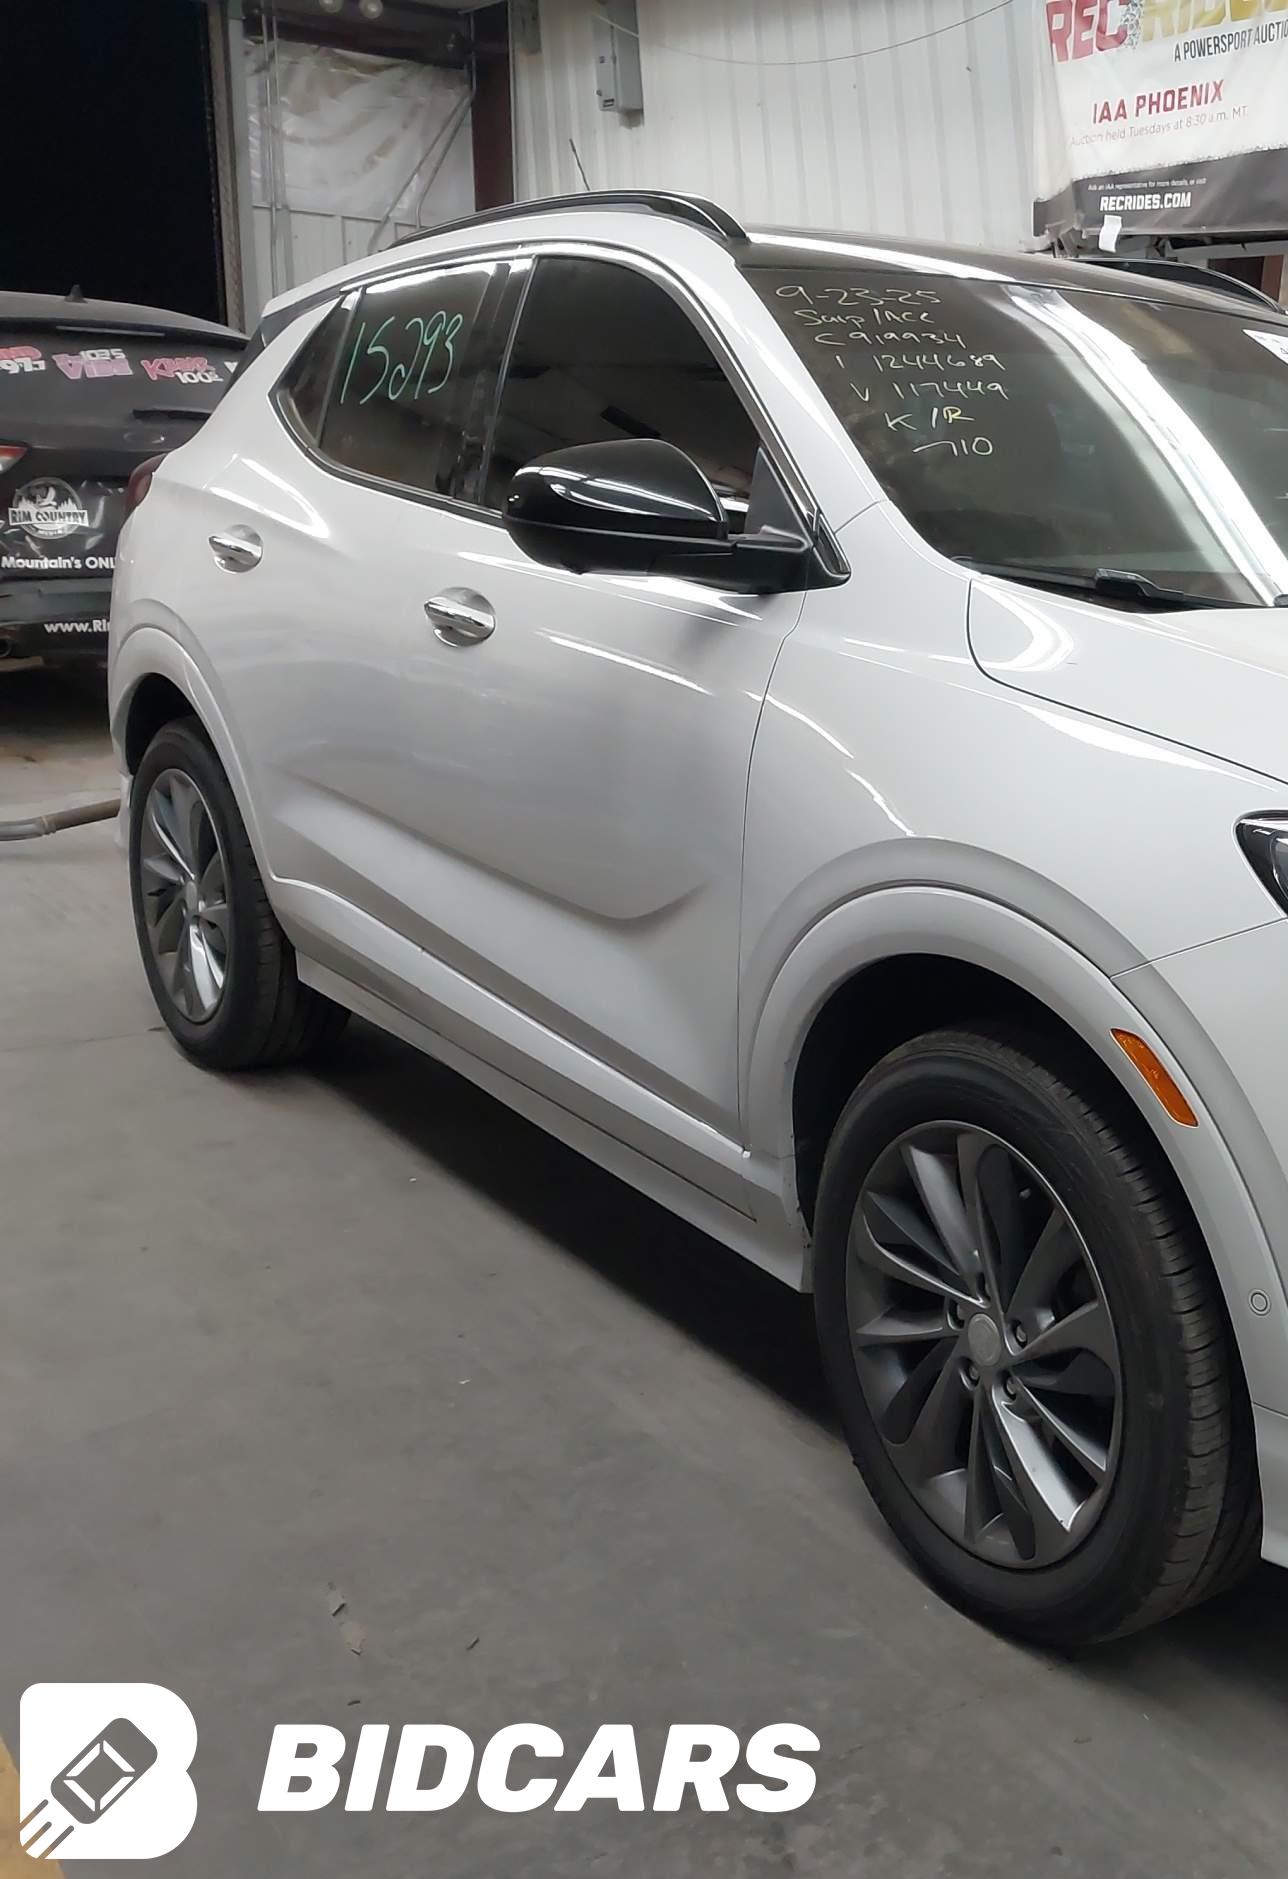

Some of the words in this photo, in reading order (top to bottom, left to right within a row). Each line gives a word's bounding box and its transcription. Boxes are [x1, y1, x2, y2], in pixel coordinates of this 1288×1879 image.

[1174, 43, 1182, 62] A
[1183, 27, 1252, 60] POWERSPORT
[1092, 98, 1128, 124] IAA
[1135, 79, 1225, 118] PHOENIX
[1106, 127, 1126, 142] held
[1129, 120, 1172, 138] Tuesdays
[1174, 119, 1183, 130] at
[1099, 191, 1192, 212] RECRIDES.COM
[10, 509, 32, 524] RIM
[36, 509, 87, 524] COUNTRY
[1, 556, 82, 570] Mountain's
